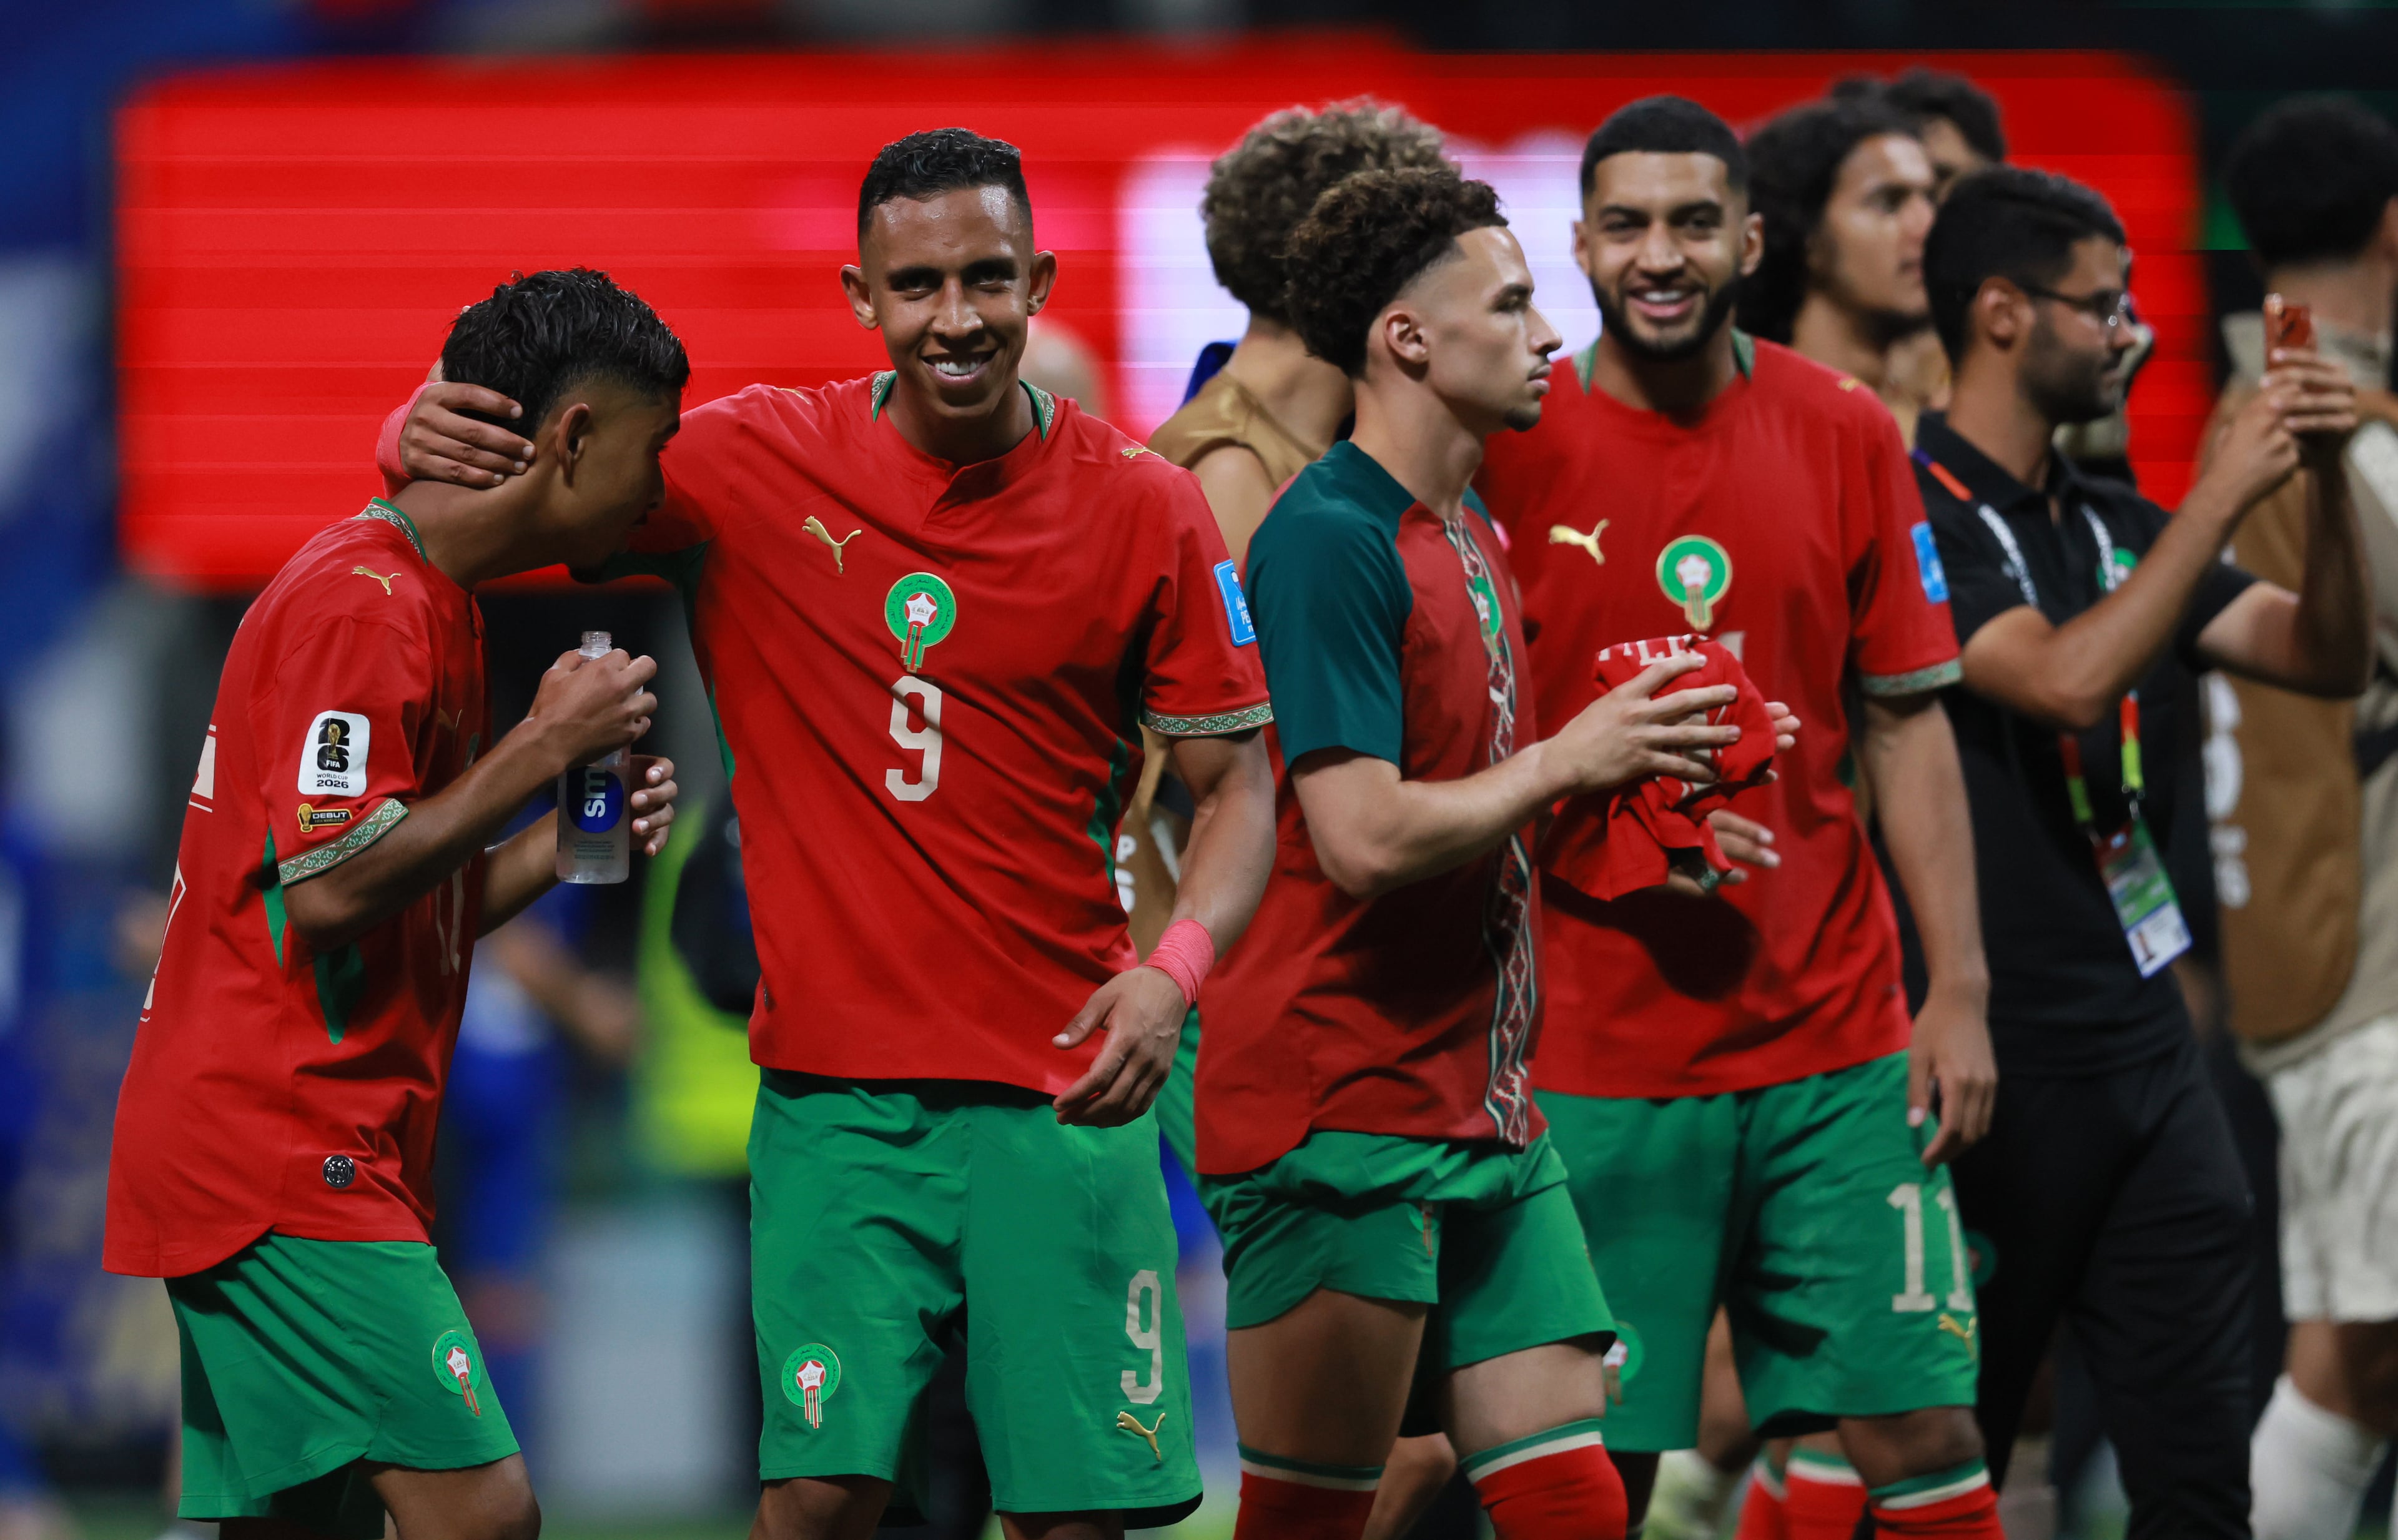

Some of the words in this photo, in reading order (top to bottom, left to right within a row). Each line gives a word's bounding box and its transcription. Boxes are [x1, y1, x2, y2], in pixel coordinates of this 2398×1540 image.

[317, 779, 349, 789] 2026
[326, 759, 341, 769] FIFA
[885, 675, 942, 802] 9
[1887, 1183, 1974, 1313] 11
[1120, 1269, 1163, 1405] 9
